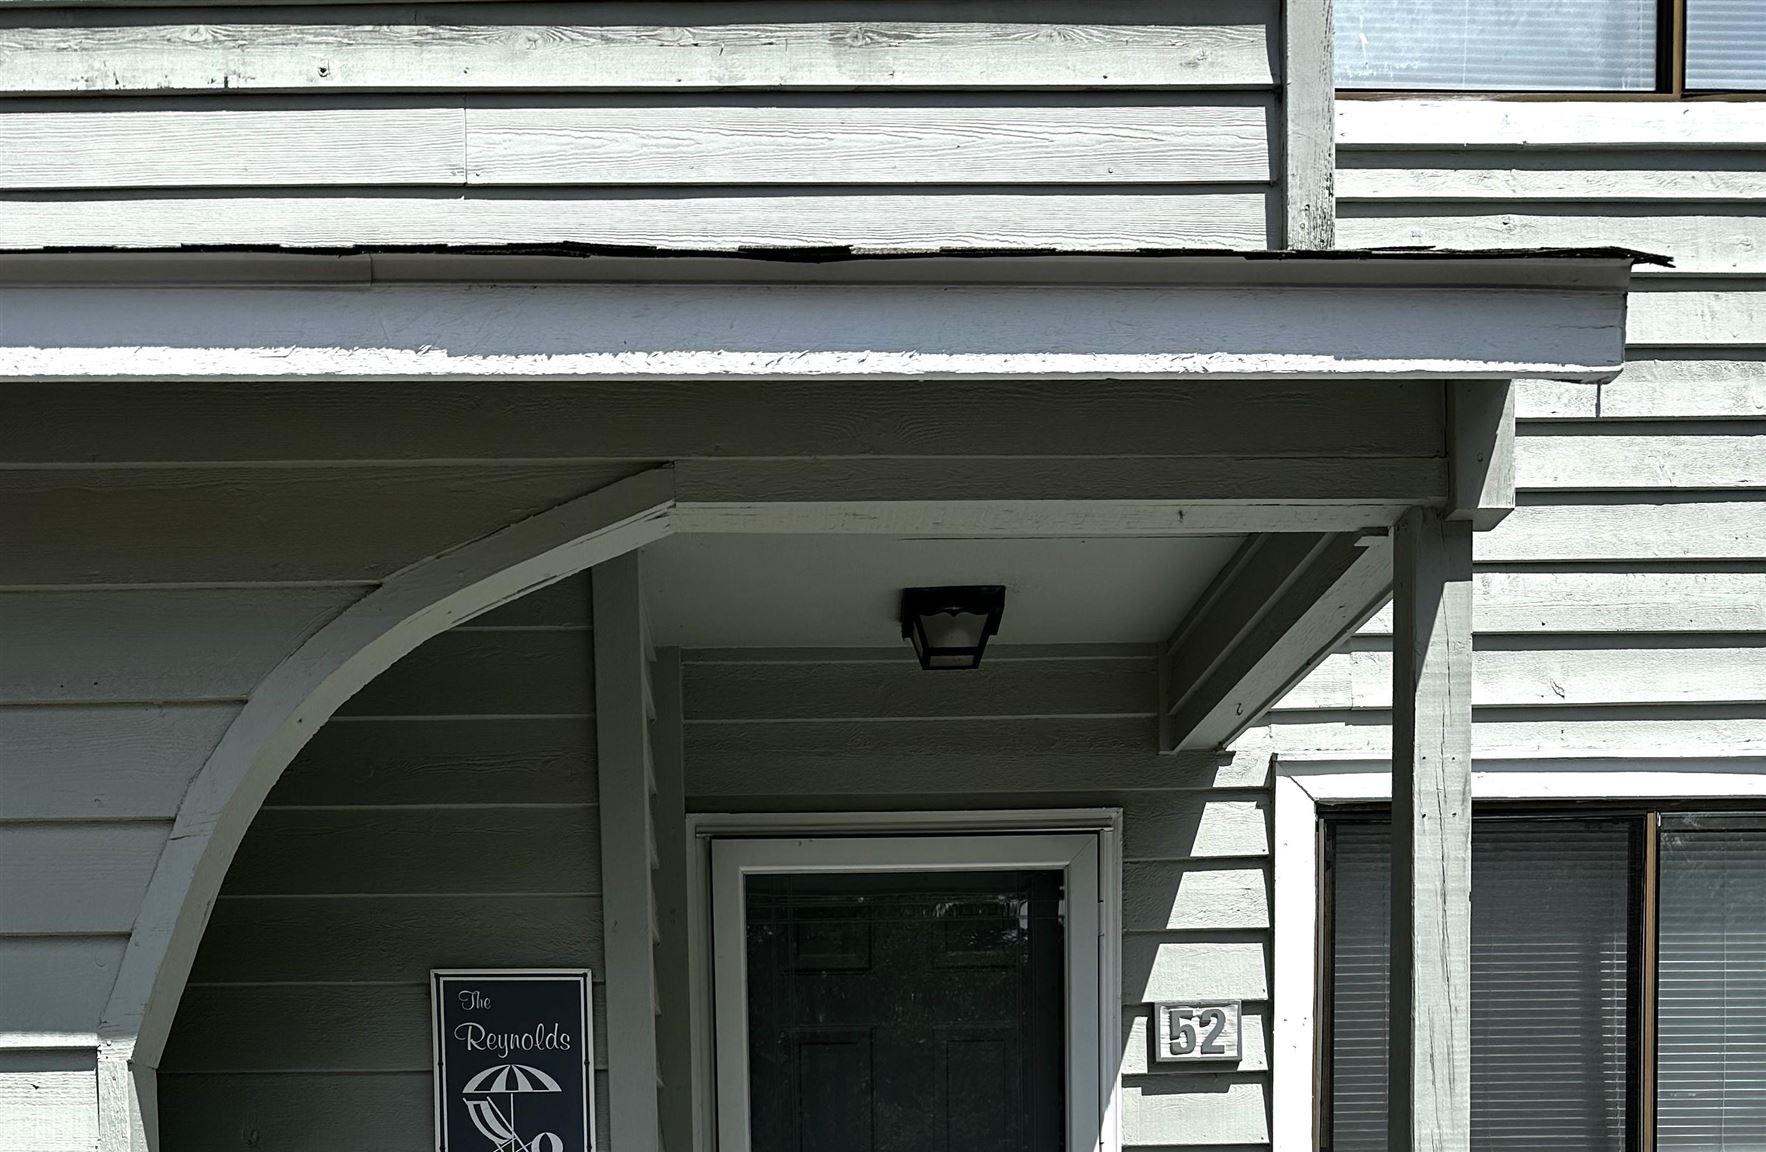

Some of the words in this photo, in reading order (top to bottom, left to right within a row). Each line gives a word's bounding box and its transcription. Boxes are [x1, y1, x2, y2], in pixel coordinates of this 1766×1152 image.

[458, 990, 491, 1011] The
[454, 1022, 571, 1059] Reynolds
[1168, 1008, 1226, 1055] 52
